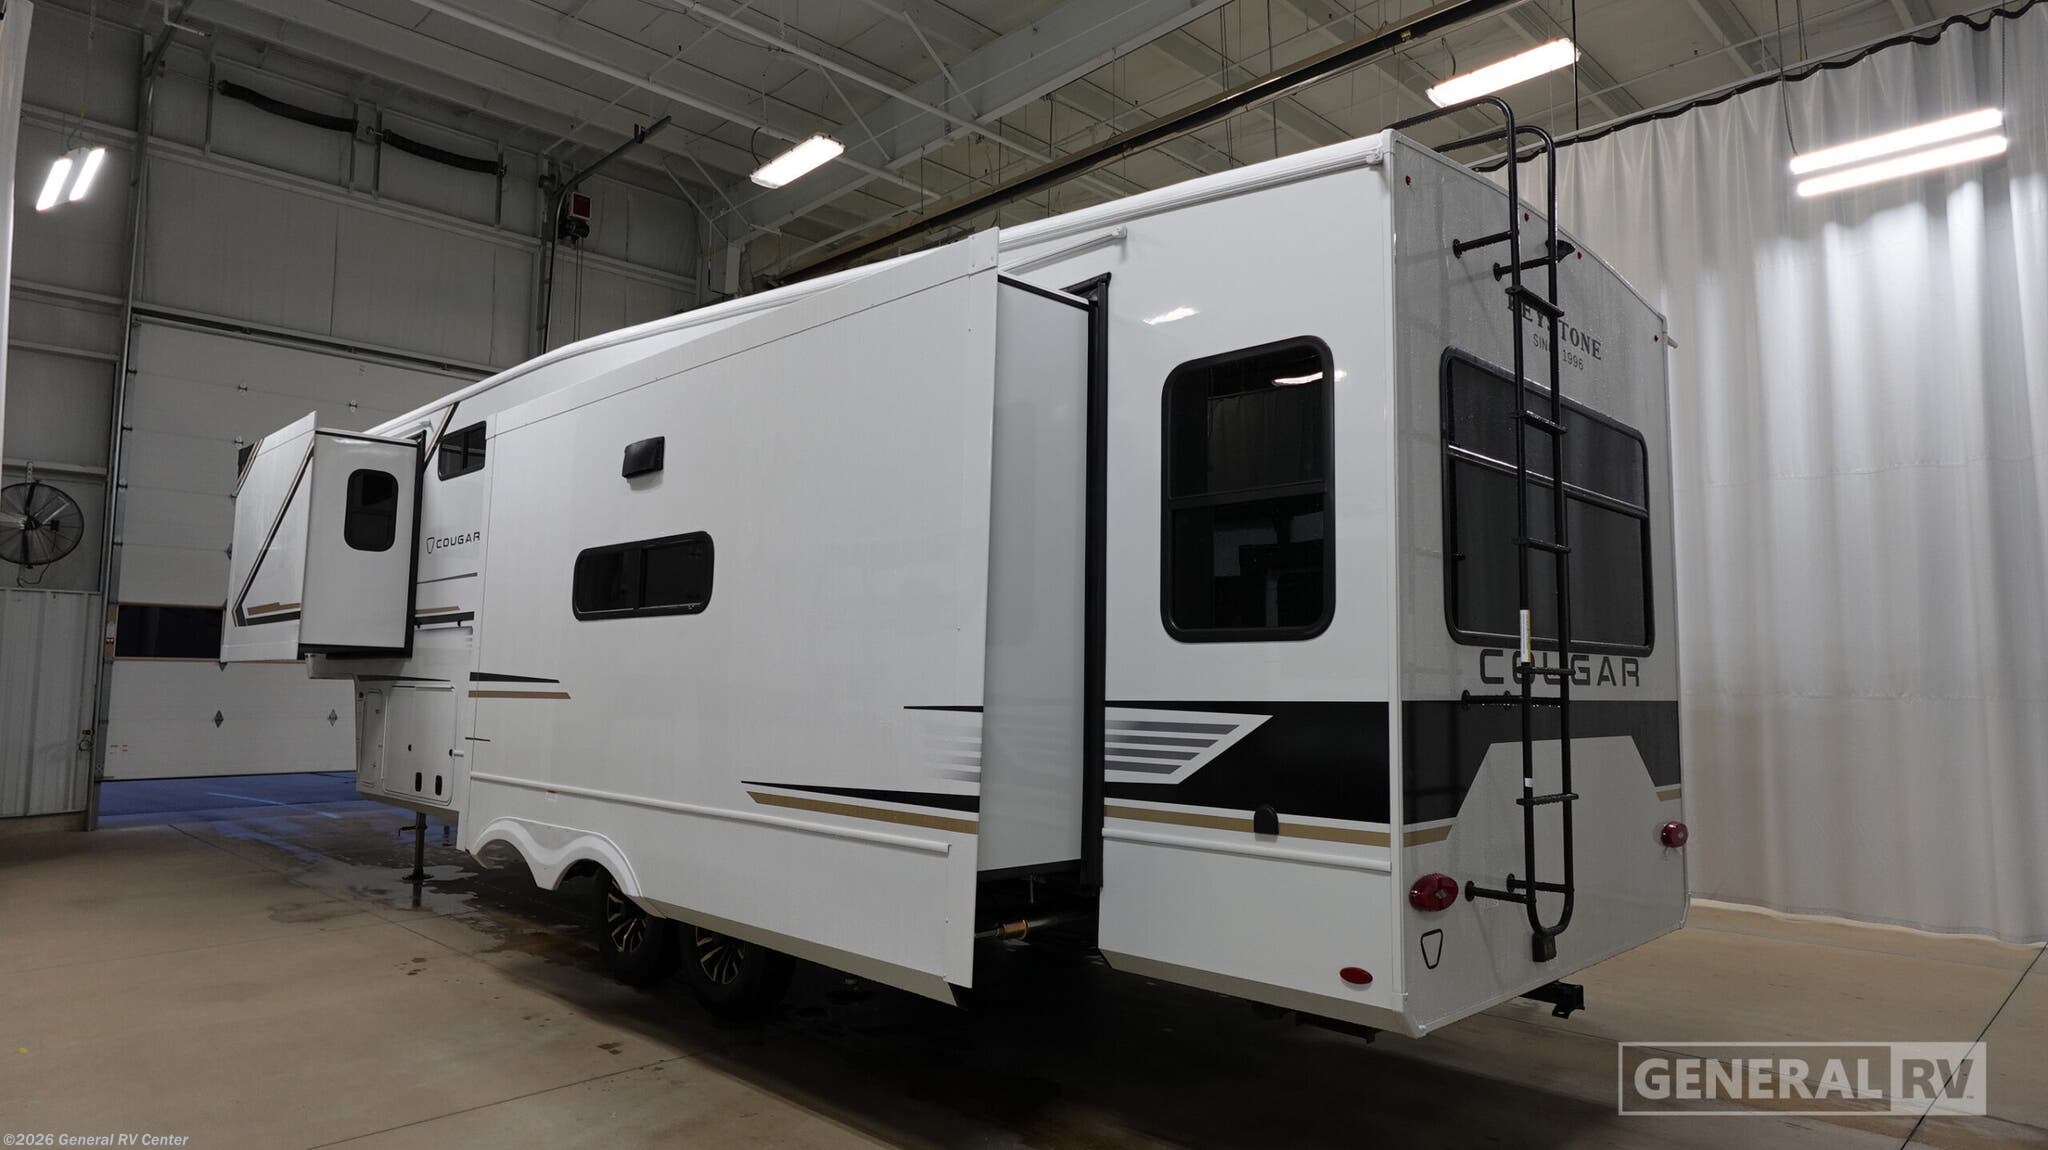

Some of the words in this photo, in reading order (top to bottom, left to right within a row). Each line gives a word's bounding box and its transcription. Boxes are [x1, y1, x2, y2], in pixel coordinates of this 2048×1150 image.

[1507, 293, 1602, 360] EYTONE
[1533, 333, 1557, 356] SIN
[1562, 349, 1584, 370] 1996
[436, 531, 480, 549] COUGAR
